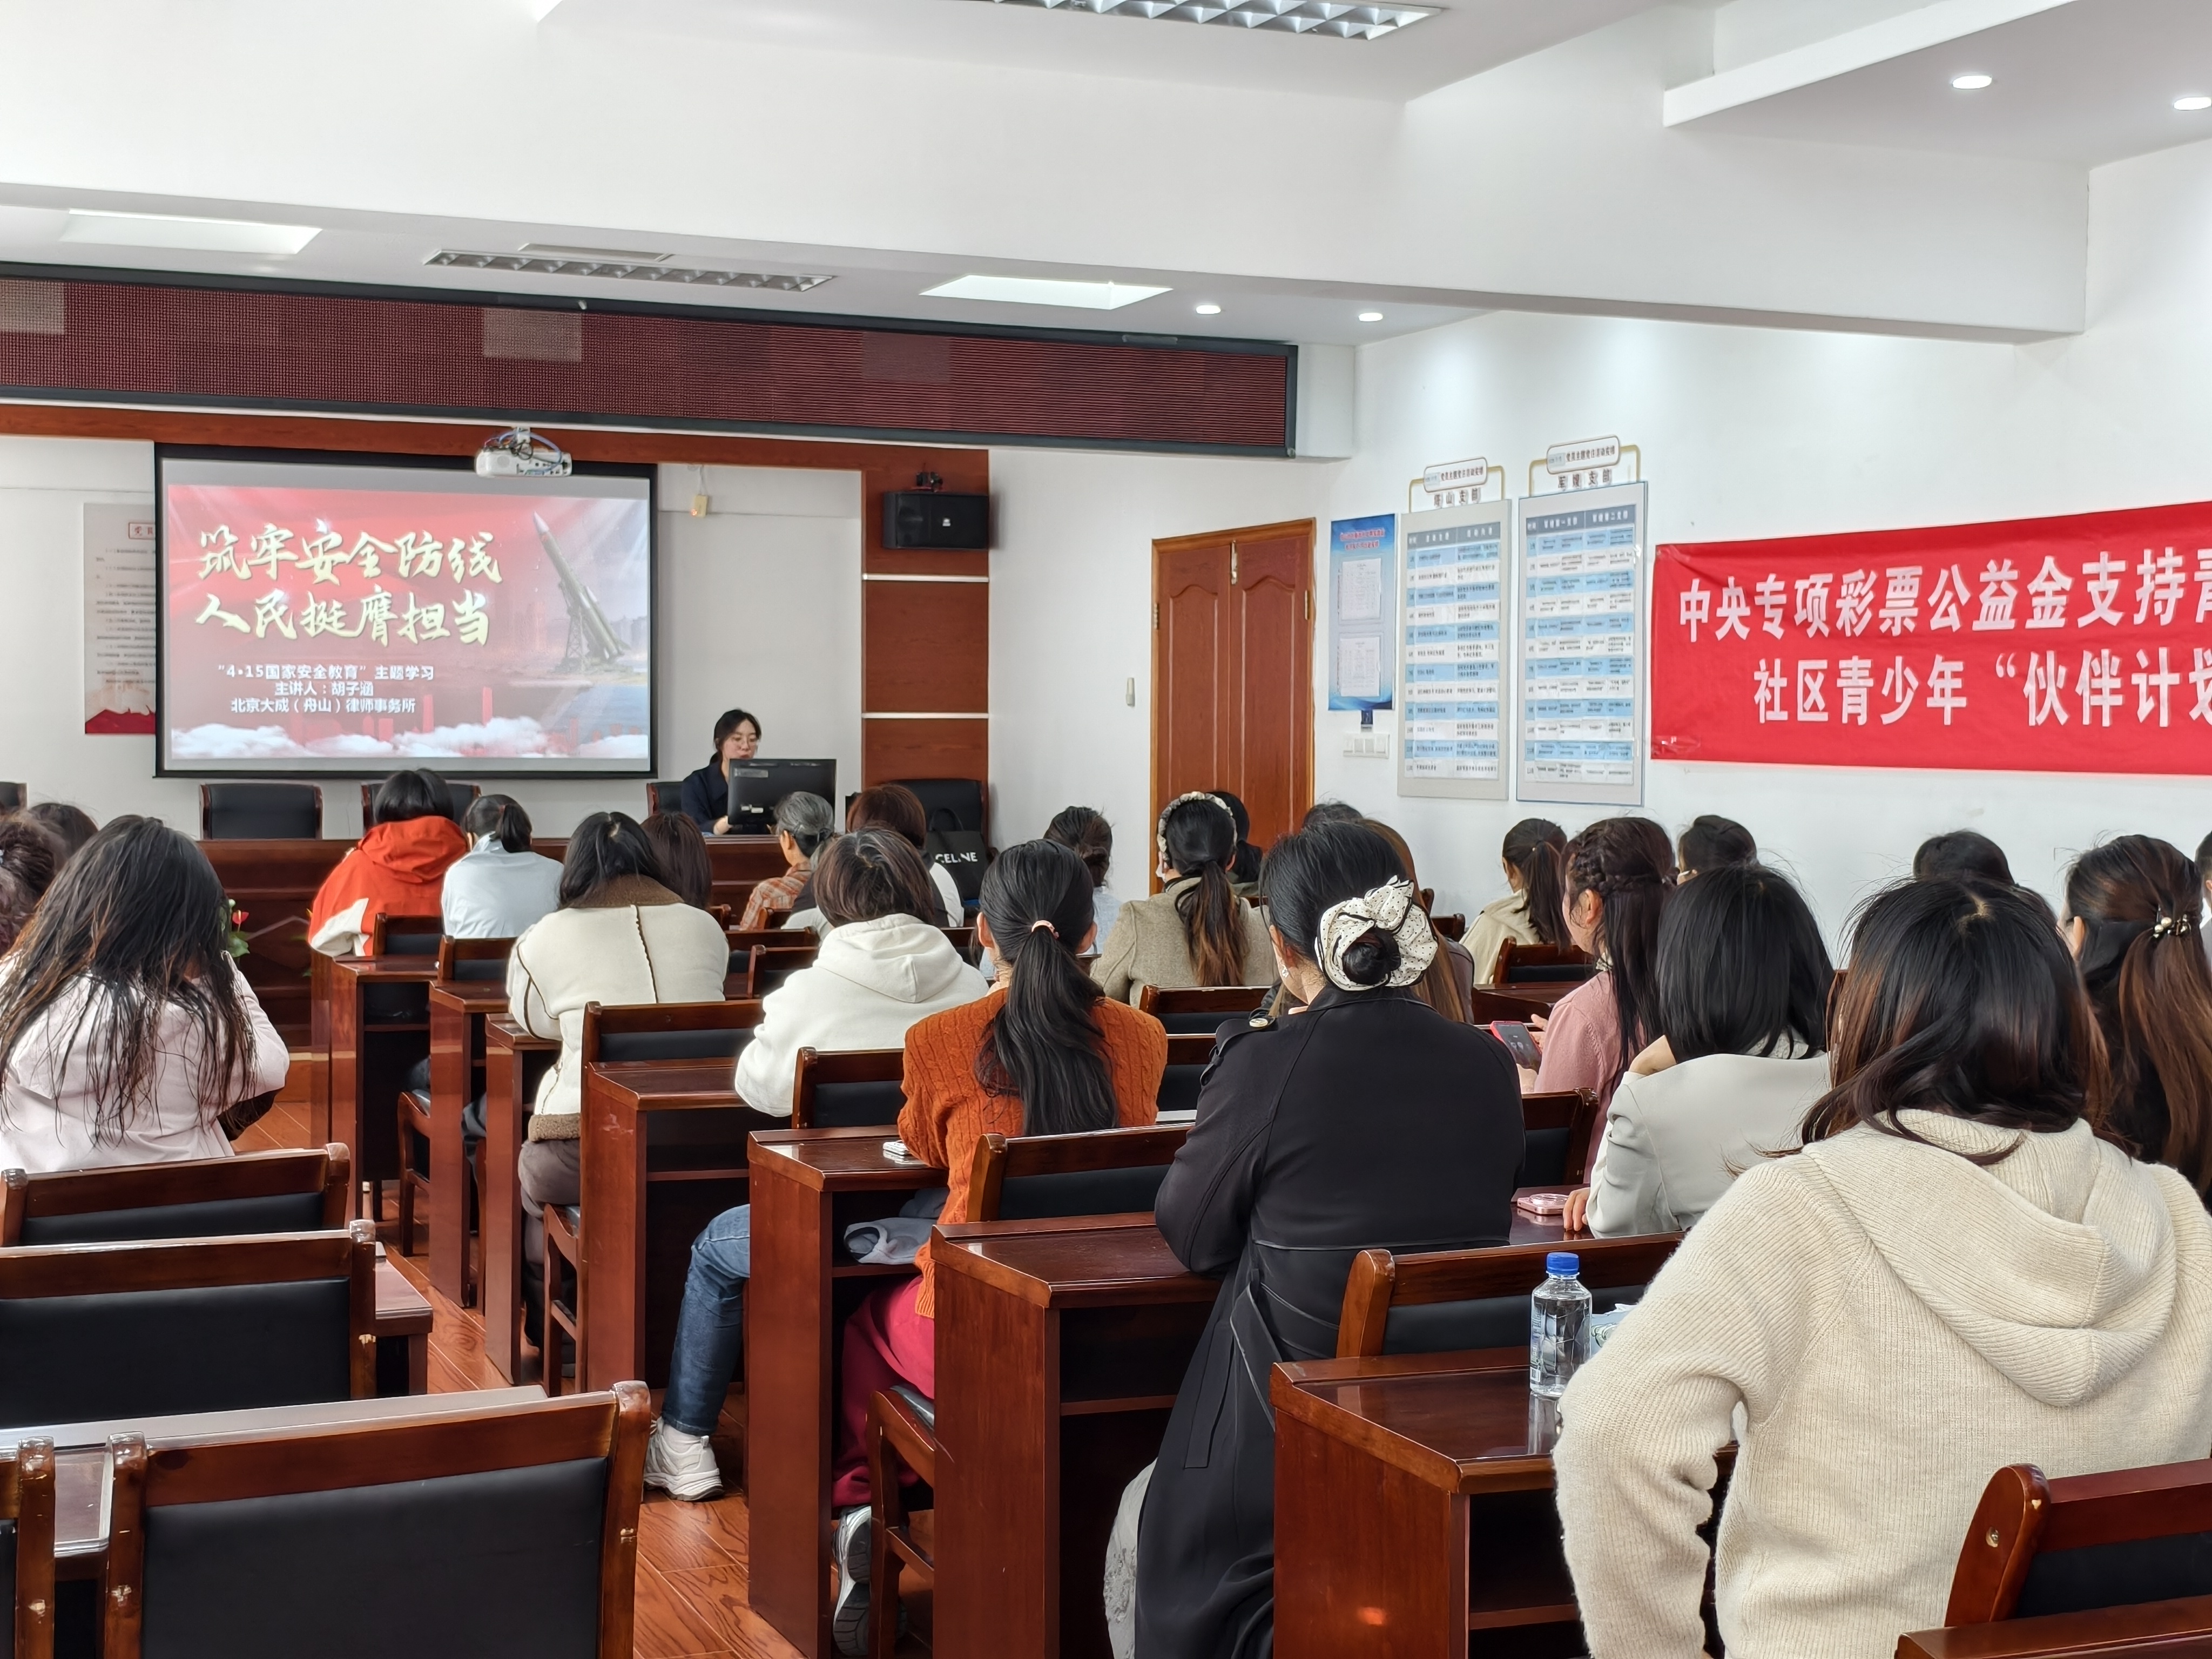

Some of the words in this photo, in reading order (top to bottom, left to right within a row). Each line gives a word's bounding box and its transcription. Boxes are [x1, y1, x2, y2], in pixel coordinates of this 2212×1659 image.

[197, 518, 503, 585] 筑牢安全防线
[195, 584, 490, 647] 人民挺膺担当
